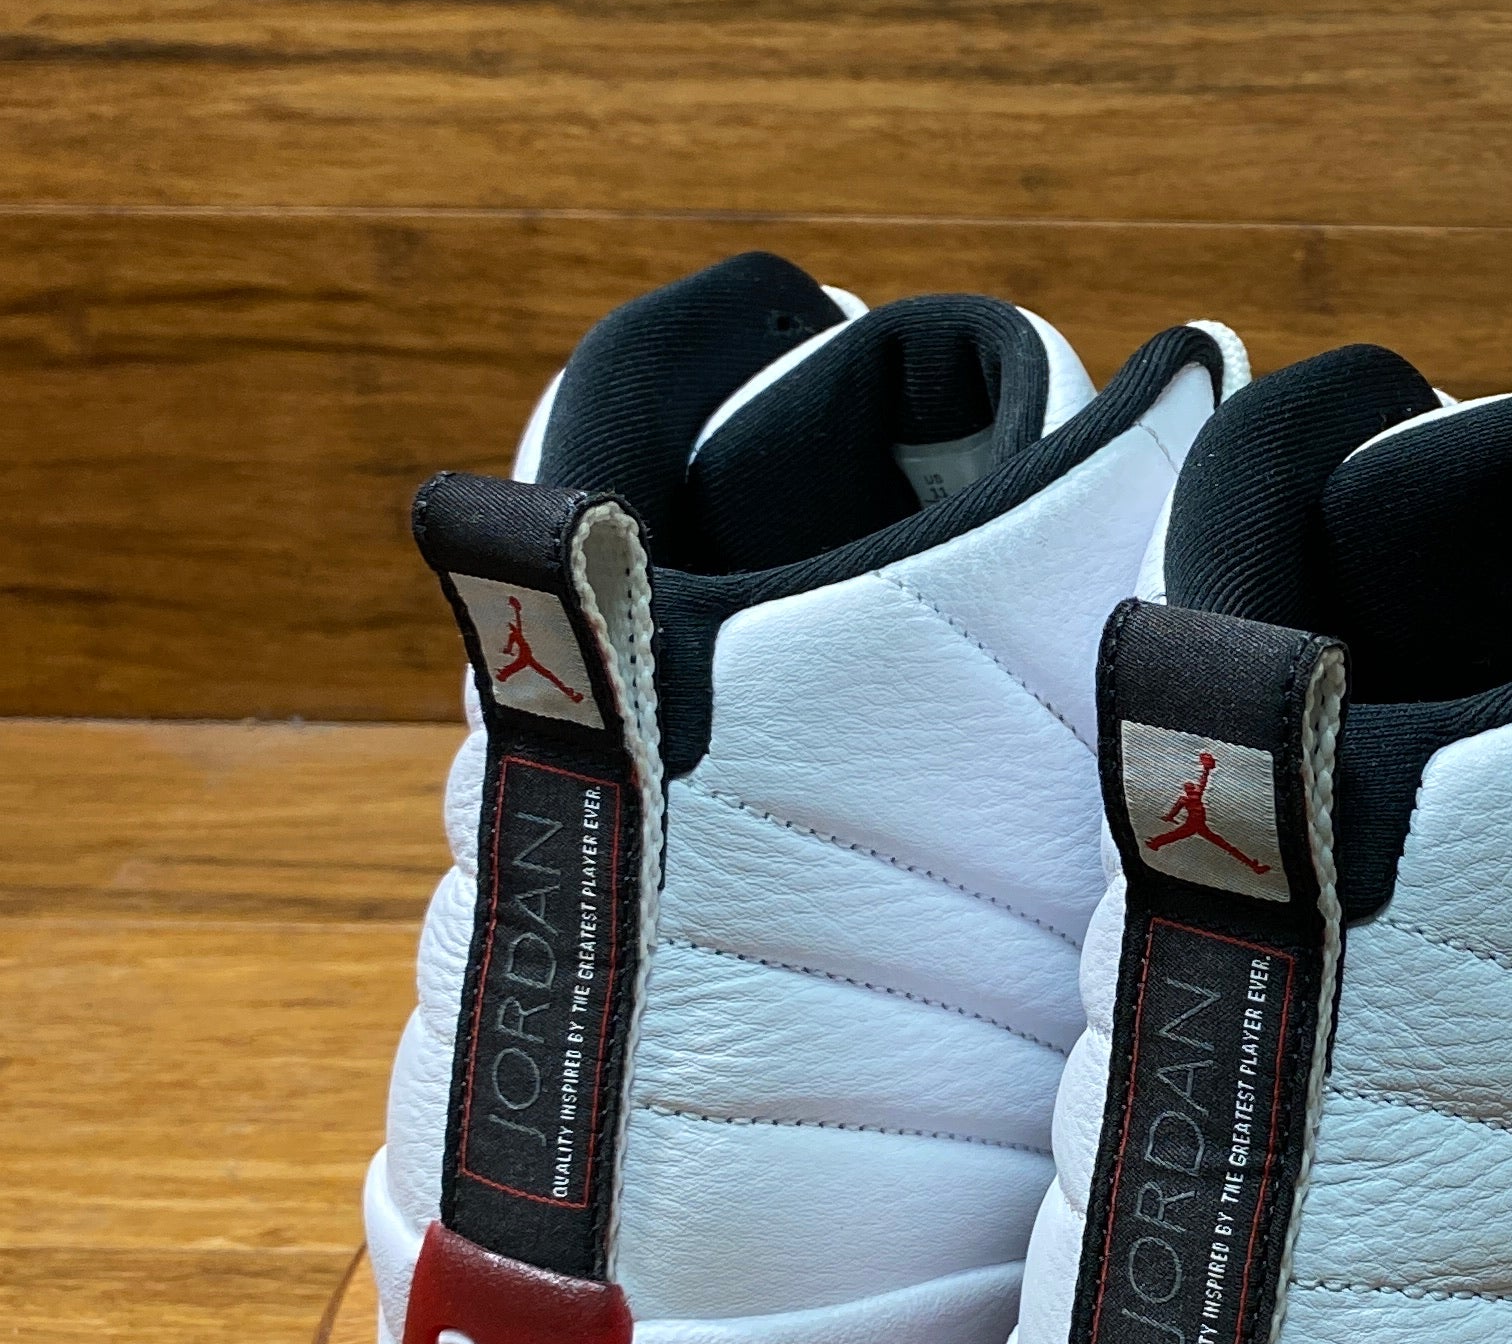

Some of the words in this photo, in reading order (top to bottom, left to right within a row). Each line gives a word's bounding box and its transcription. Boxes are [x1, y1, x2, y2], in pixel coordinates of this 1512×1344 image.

[583, 785, 602, 830] EVER.
[581, 834, 600, 897] PLAYER
[577, 901, 598, 981] GREATEST
[487, 811, 564, 1147] JORDAN
[572, 984, 591, 1013] THE
[1247, 955, 1272, 1003] EVER.
[567, 1021, 585, 1043] BY
[1239, 1008, 1264, 1075] PLAYER
[560, 1049, 582, 1121] INSPIRED
[1228, 1080, 1256, 1168] GREATEST
[553, 1125, 574, 1198] QUALITY
[1220, 1171, 1244, 1203] THE
[1214, 1211, 1234, 1236] BY
[1202, 1241, 1231, 1319] INSPIRED
